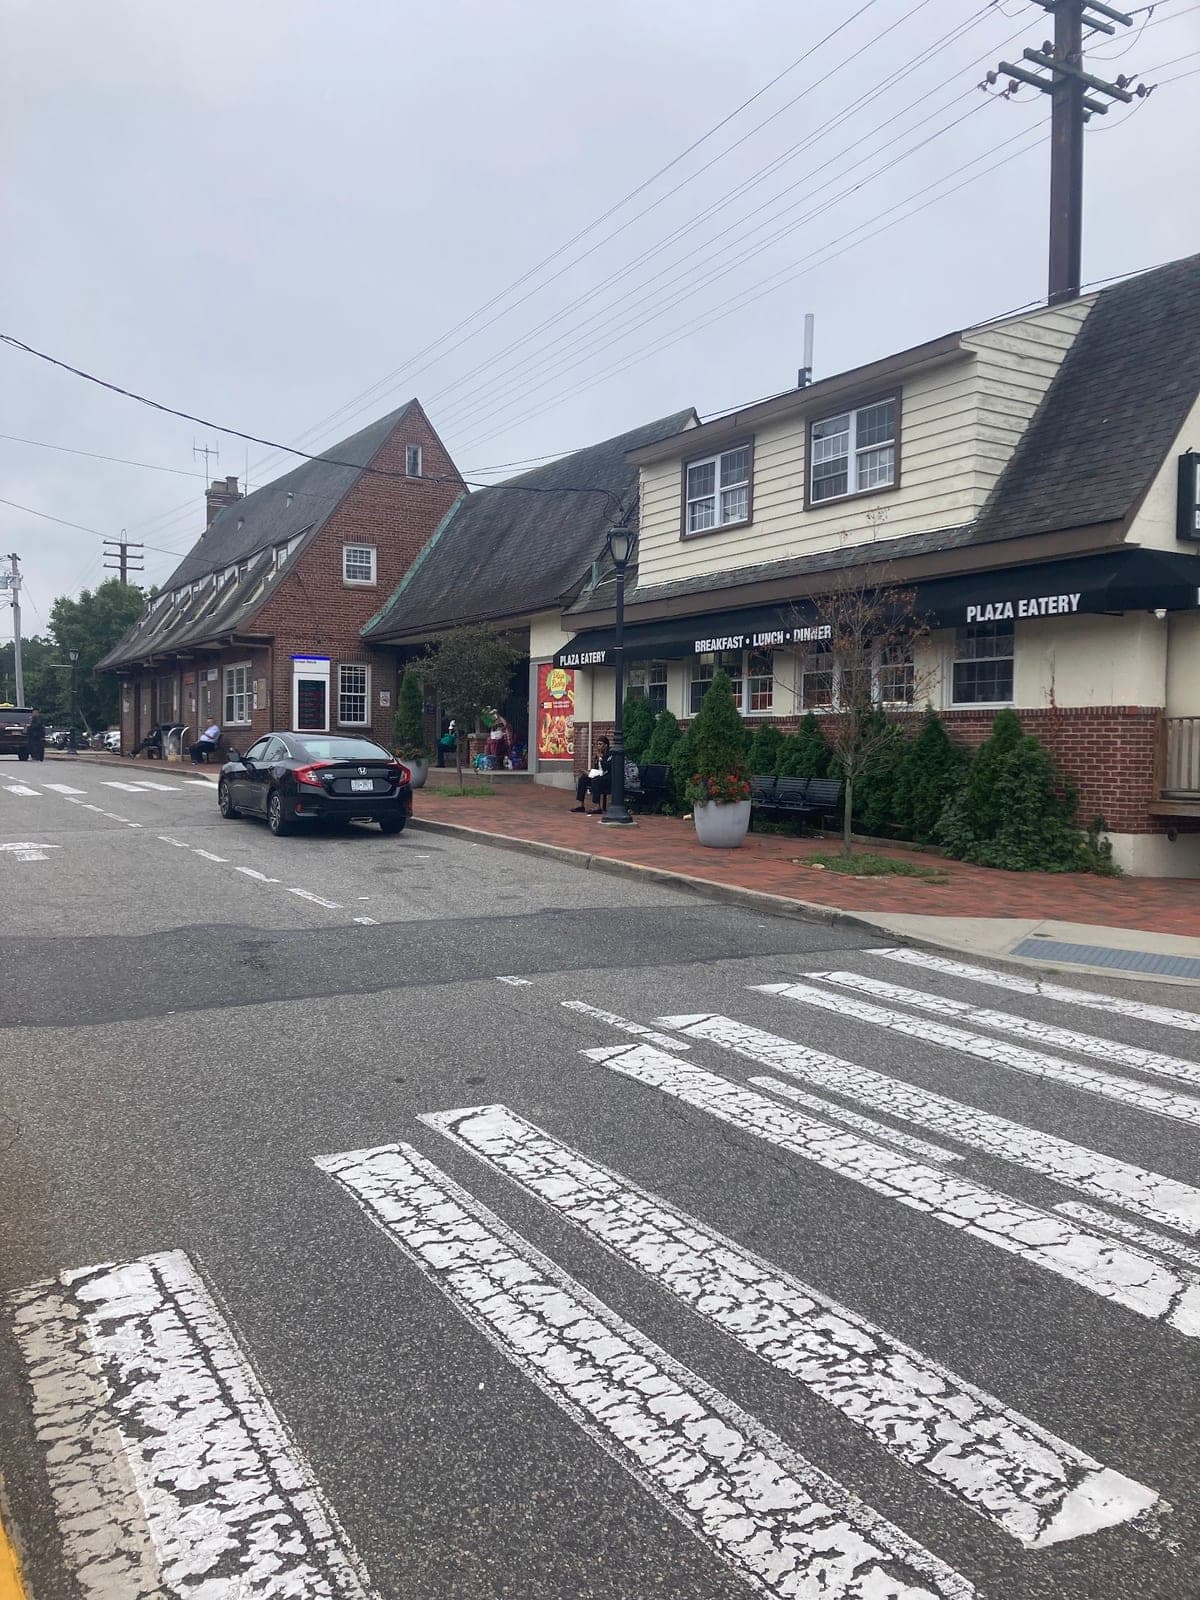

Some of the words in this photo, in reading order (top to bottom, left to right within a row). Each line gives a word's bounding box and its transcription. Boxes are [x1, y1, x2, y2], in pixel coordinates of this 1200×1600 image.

[966, 602, 1014, 623] PLAZA
[1018, 593, 1081, 617] EATERY
[695, 635, 744, 653] BREAKFAST
[752, 630, 784, 647] LUNCH
[559, 653, 580, 667] PLAZA
[580, 650, 606, 665] EATERY
